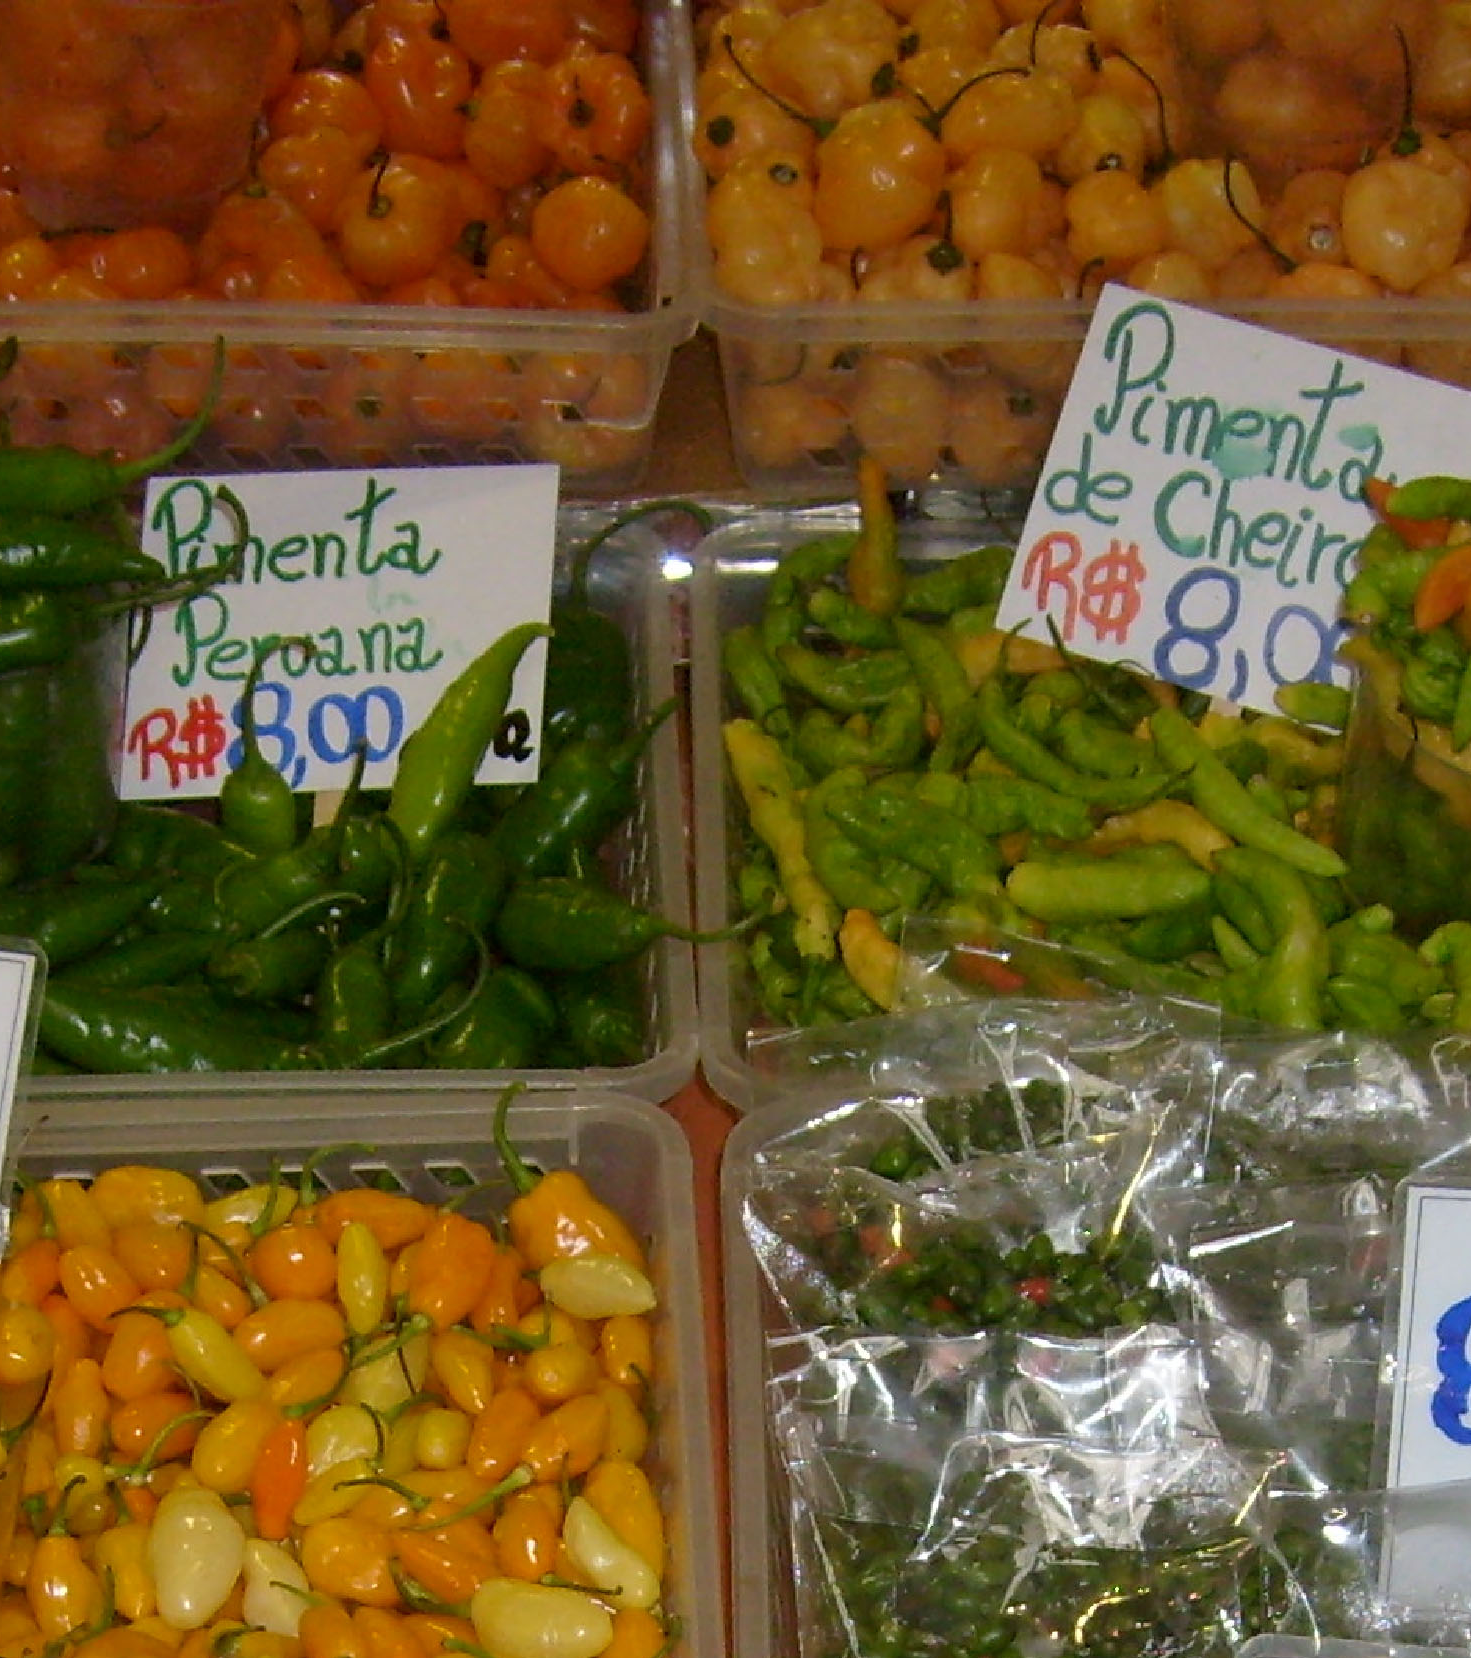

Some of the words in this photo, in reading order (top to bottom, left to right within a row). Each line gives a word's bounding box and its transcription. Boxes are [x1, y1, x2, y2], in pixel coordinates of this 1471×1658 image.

[1094, 301, 1398, 506] Pimenta
[151, 476, 443, 586] Pimenta
[1043, 432, 1133, 526] de
[1021, 530, 1147, 645] R$
[1153, 567, 1354, 701] 8,0
